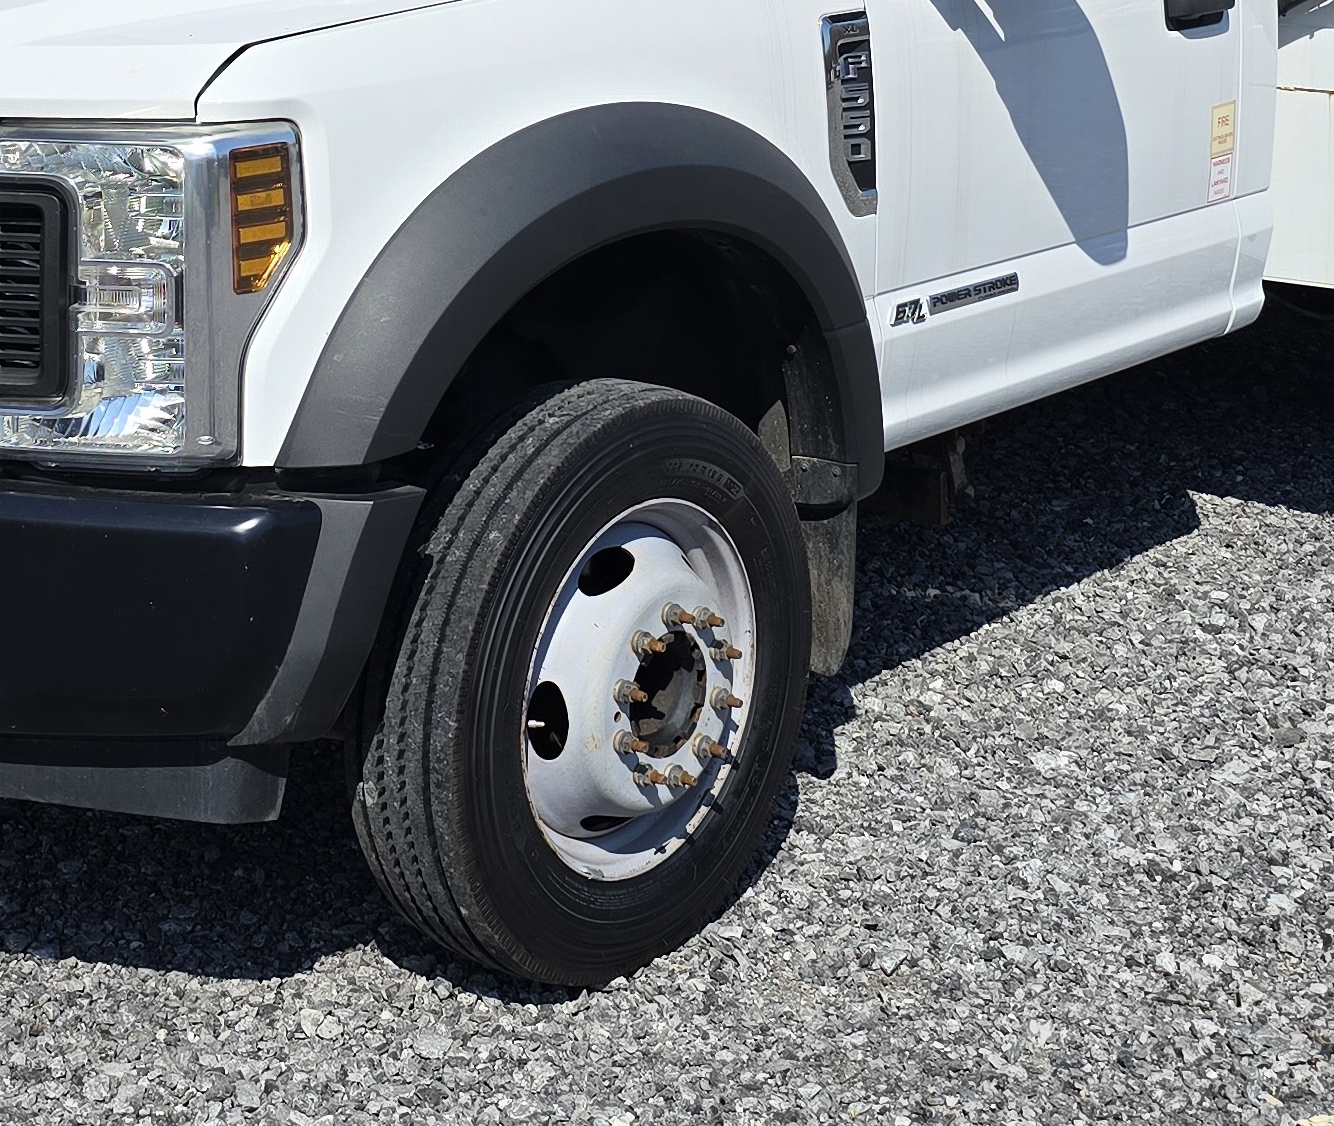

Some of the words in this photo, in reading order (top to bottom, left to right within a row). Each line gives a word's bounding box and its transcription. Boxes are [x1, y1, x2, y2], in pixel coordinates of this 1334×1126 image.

[843, 25, 859, 34] XL
[1217, 114, 1230, 128] FIRE
[932, 288, 972, 308] POWER
[973, 274, 1017, 296] STROKE
